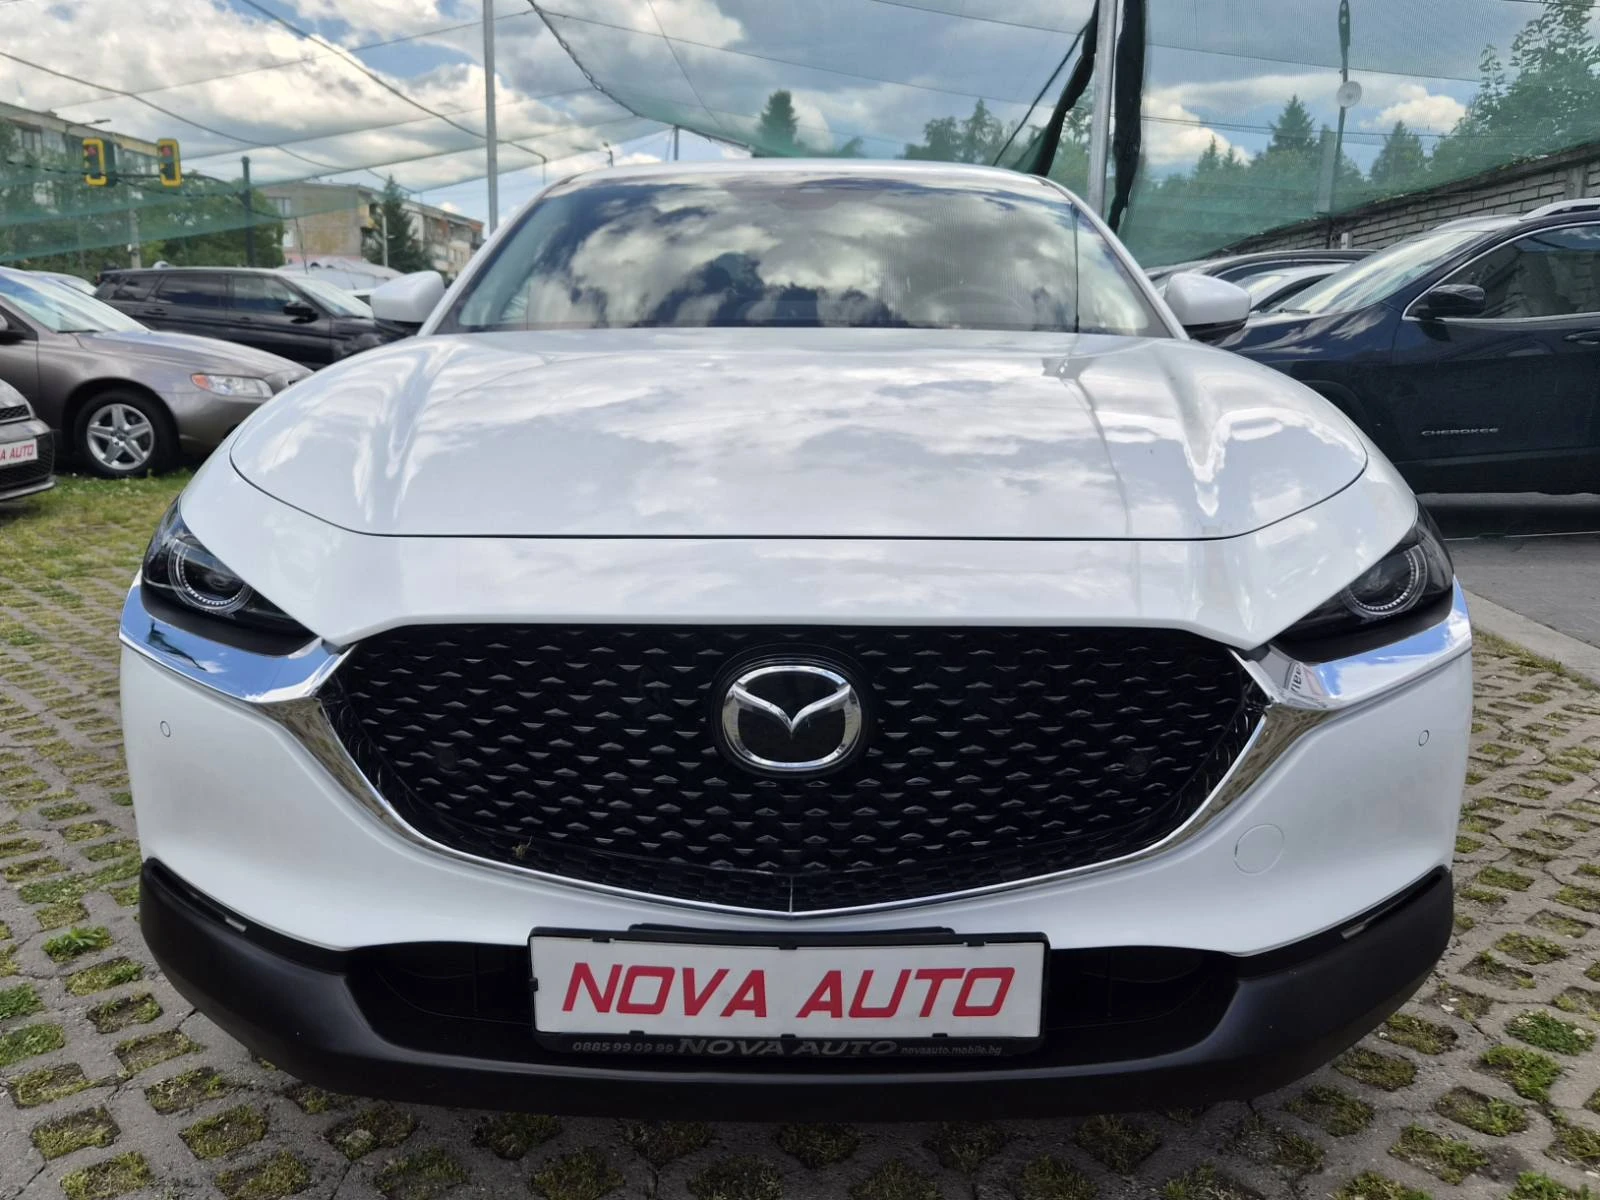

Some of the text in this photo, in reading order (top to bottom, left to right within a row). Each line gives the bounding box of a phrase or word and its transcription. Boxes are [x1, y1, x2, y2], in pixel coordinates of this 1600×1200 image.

[1421, 427, 1499, 437] CHEROKEE
[10, 444, 34, 458] AUTO
[562, 962, 1016, 1018] NOVA AUTO
[572, 1041, 611, 1052] 0885
[677, 1038, 784, 1055] NOVA
[792, 1039, 898, 1055] AUTO
